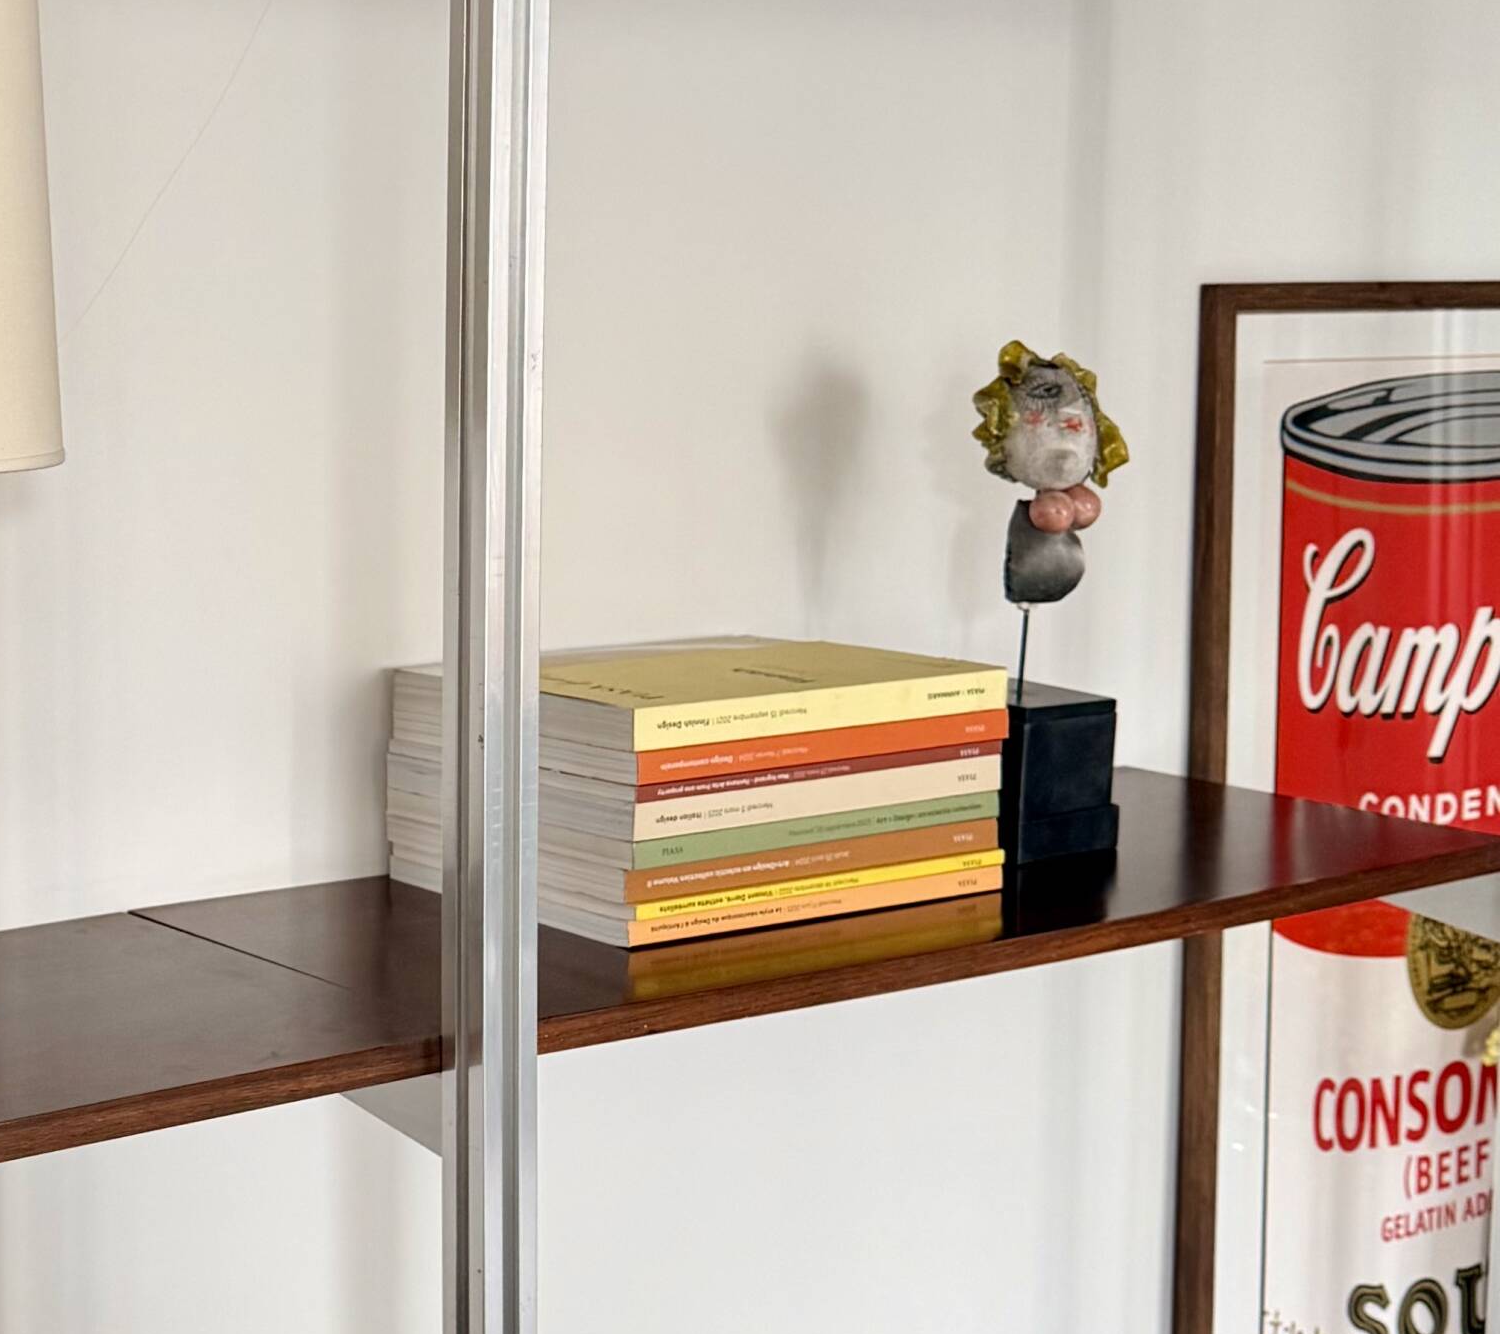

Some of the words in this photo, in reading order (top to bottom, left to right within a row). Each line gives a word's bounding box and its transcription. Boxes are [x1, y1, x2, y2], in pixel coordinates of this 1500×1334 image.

[656, 718, 682, 730] Design
[683, 717, 710, 728] Finnish
[655, 813, 678, 824] design
[678, 811, 702, 821] Italian
[747, 889, 773, 900] Vincent
[690, 916, 710, 927] Design
[1381, 1200, 1456, 1243] GELATIN
